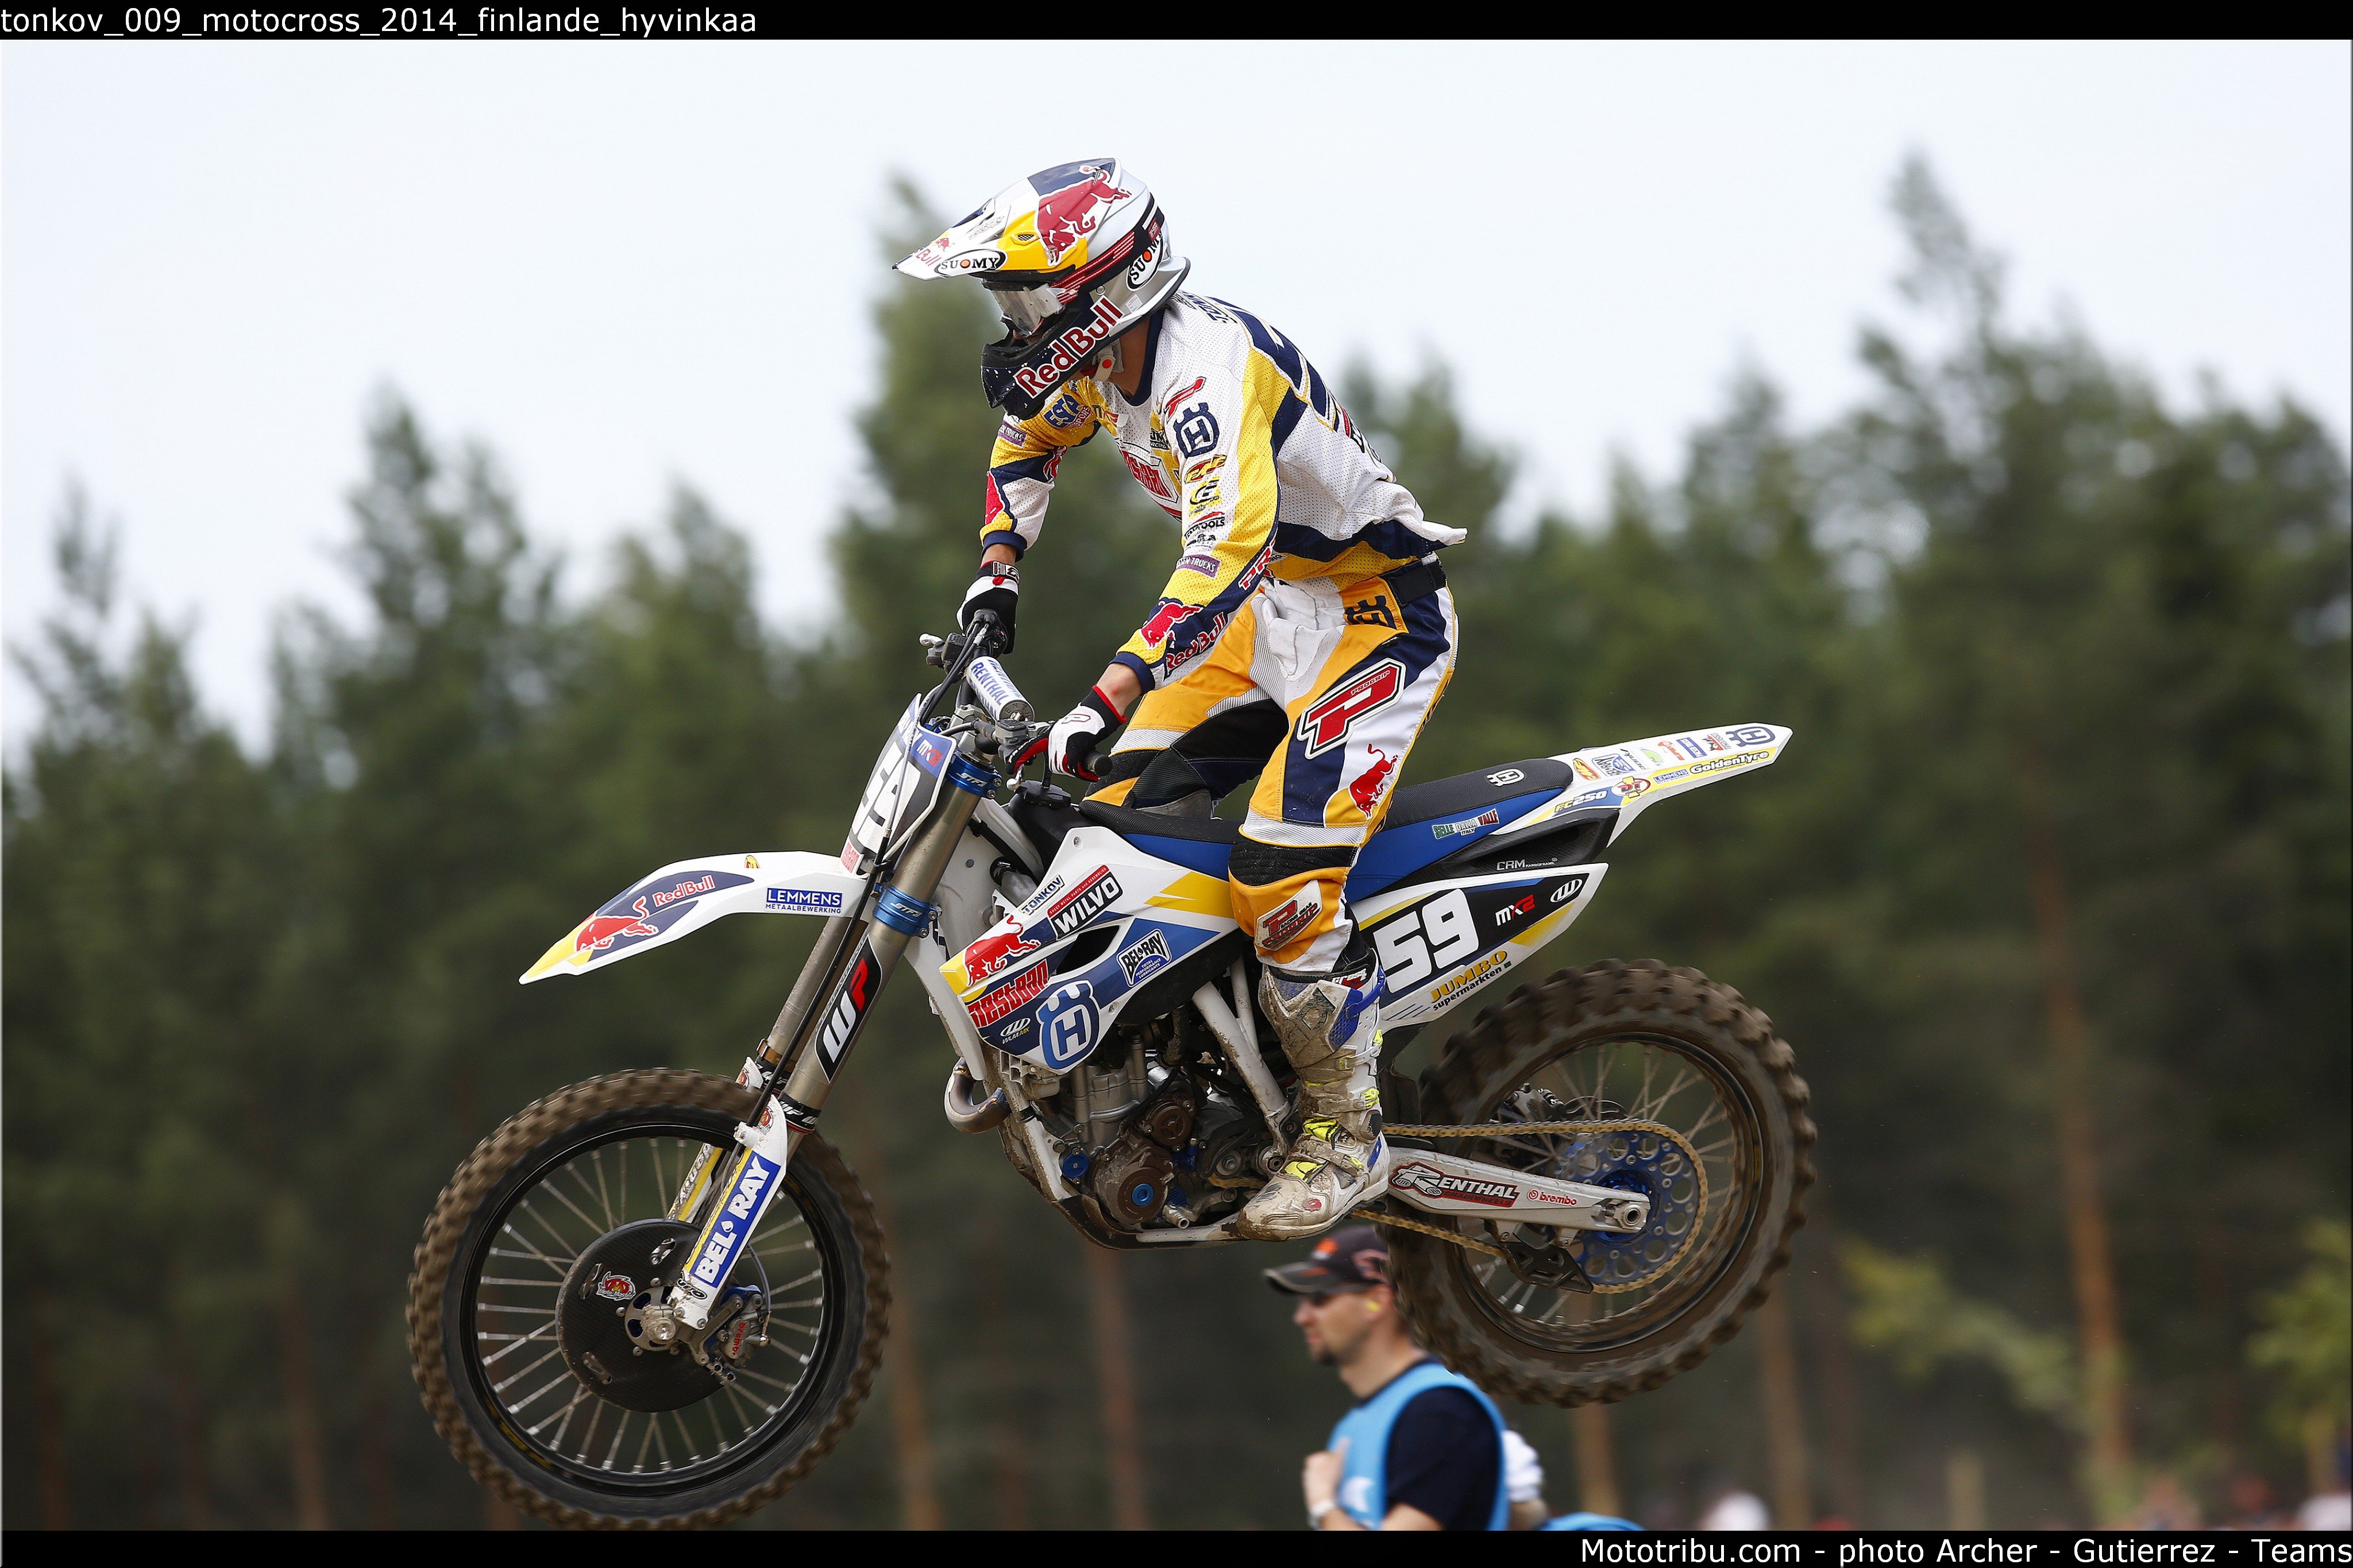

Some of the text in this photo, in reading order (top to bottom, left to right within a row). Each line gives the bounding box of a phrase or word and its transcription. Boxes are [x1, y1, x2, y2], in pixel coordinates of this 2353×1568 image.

[941, 257, 999, 269] SUOMY
[1015, 341, 1078, 397] Red
[1063, 296, 1124, 356] Bull
[1190, 557, 1216, 573] TRUCKS
[1166, 612, 1227, 671] Red Bull
[971, 662, 1009, 706] RENTHAL
[1350, 670, 1390, 696] PROGRIP
[1690, 751, 1769, 774] GoldenTyre
[1554, 790, 1608, 813] FC250
[1455, 818, 1478, 833] DALLA
[1478, 808, 1499, 827] VALLE
[1496, 859, 1525, 871] CRM
[653, 874, 716, 907] Red Bull
[767, 890, 842, 906] LEMMENS
[1020, 875, 1064, 914] TONKOV
[765, 903, 842, 914] METAALBEWERKING
[1050, 905, 1060, 914] SHEET
[1060, 897, 1071, 906] METAL
[1054, 876, 1121, 934] WILVO
[1495, 894, 1535, 926] MX2
[1373, 888, 1479, 994] 59
[1136, 957, 1162, 977] PERFORMANCE
[1141, 959, 1154, 968] TOTAL
[1430, 950, 1508, 1004] JUMBO
[1433, 966, 1502, 1011] supermarkten
[727, 1156, 770, 1221] RAY
[1540, 1192, 1577, 1206] brembo
